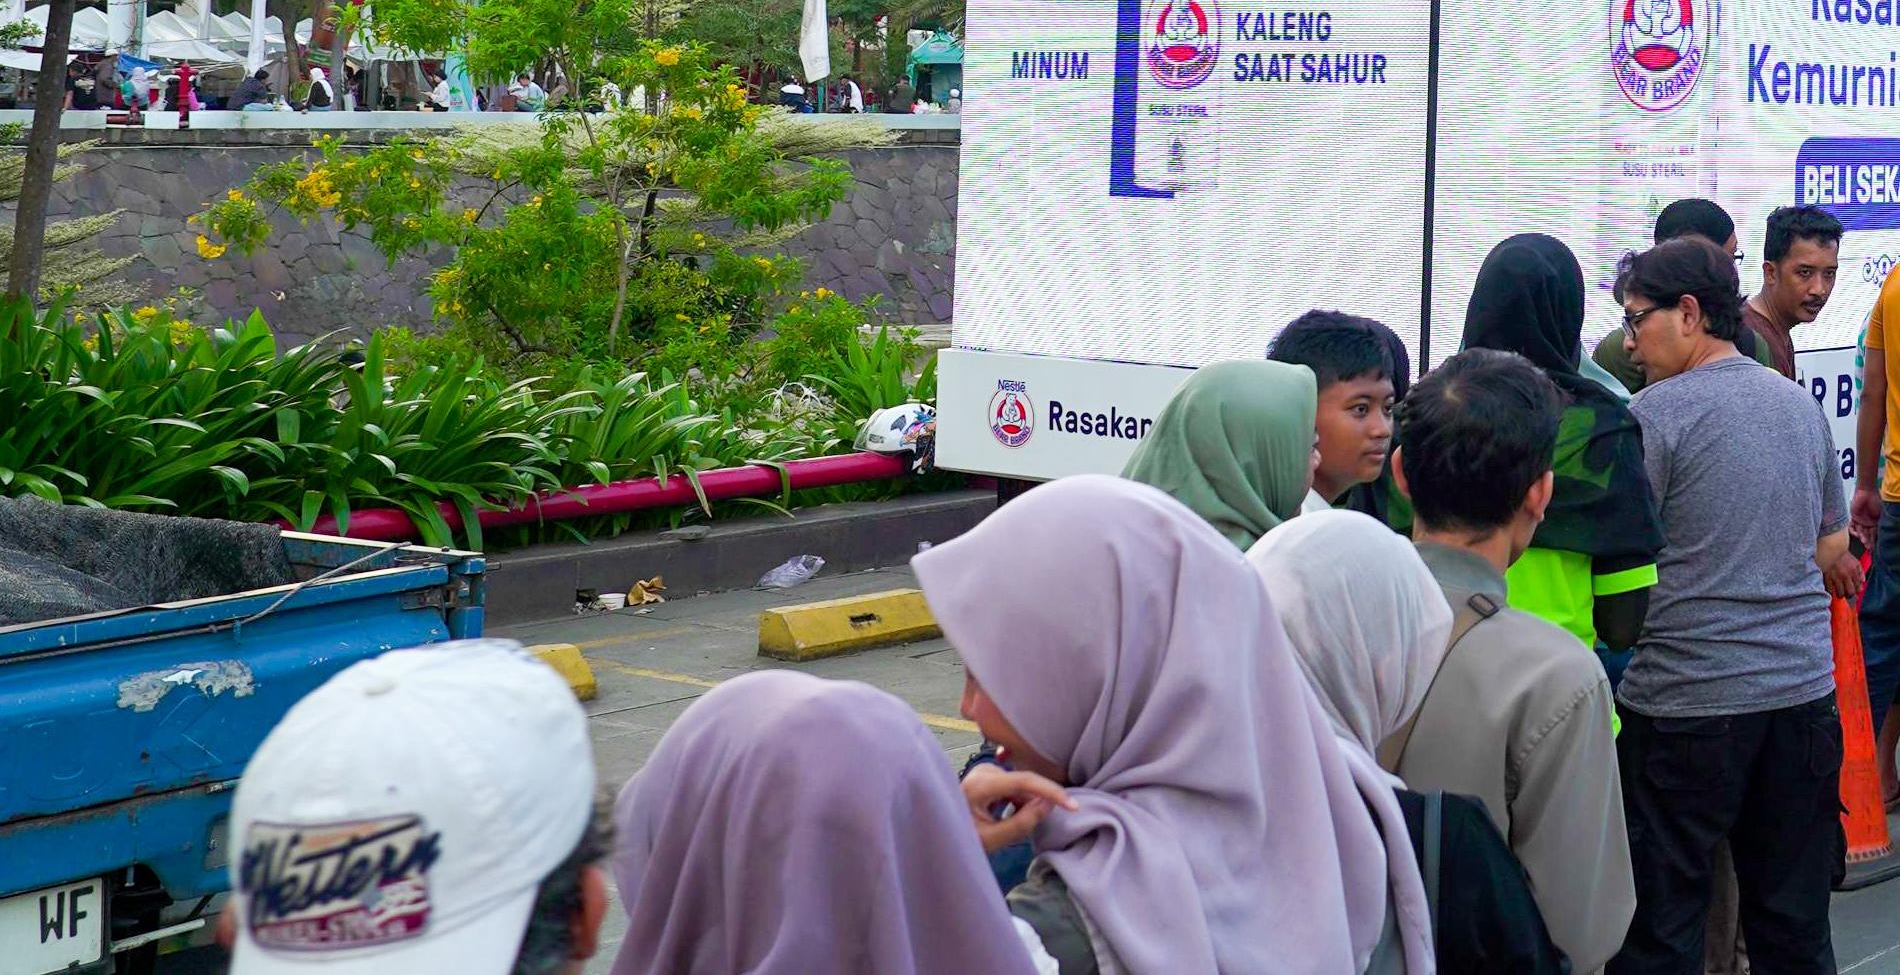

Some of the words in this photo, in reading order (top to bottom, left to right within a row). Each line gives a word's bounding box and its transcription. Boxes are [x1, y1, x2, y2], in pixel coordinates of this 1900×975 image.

[1236, 11, 1332, 41] KALENG
[1012, 50, 1090, 79] MINUM
[1234, 53, 1297, 83] SAAT
[1301, 53, 1387, 84] SAHUR
[1652, 47, 1702, 99] BRAND
[1623, 161, 1648, 177] SUSU
[1803, 164, 1853, 204] BELI
[39, 885, 94, 944] WF
